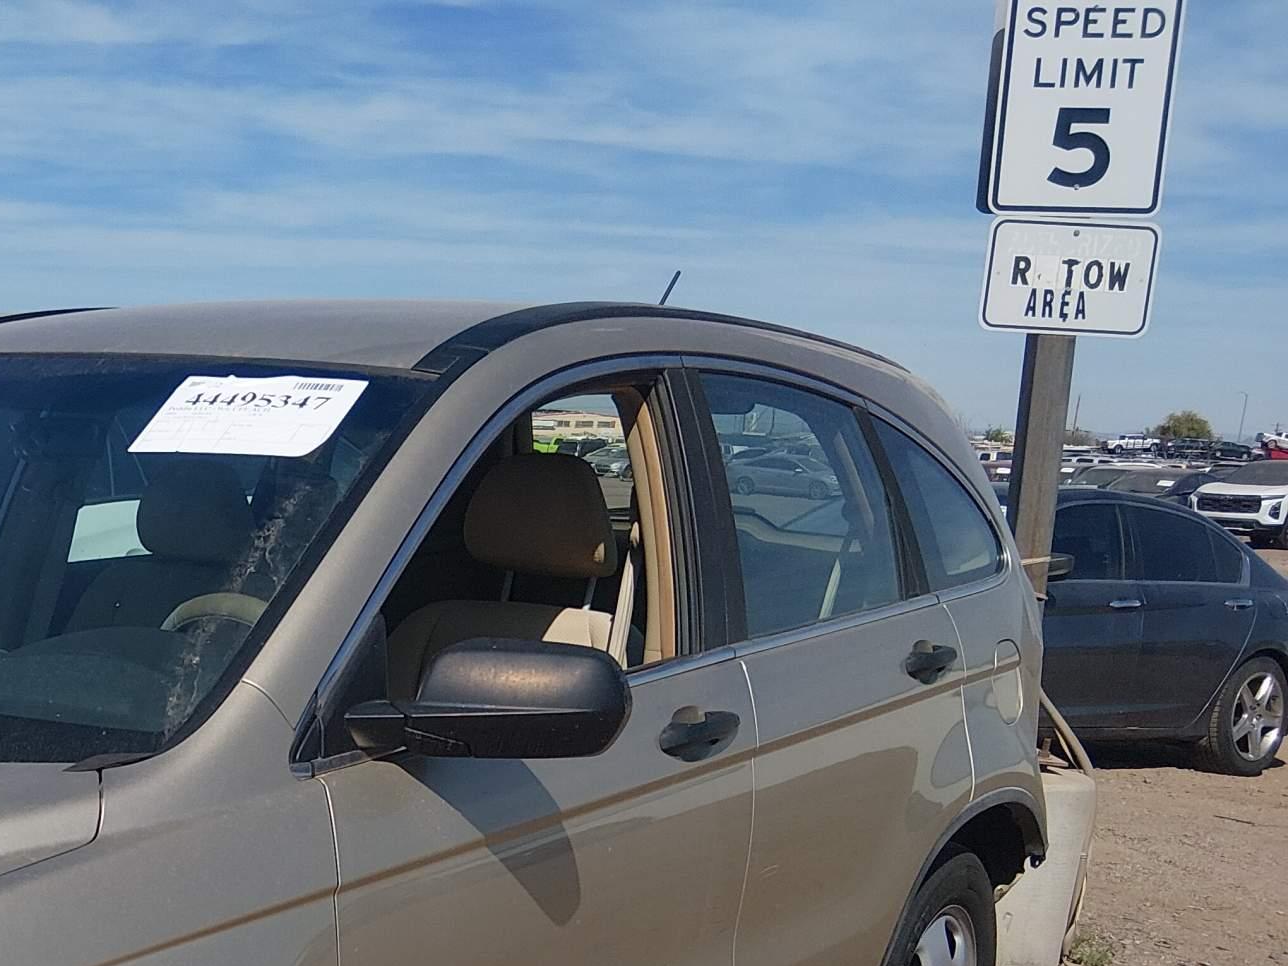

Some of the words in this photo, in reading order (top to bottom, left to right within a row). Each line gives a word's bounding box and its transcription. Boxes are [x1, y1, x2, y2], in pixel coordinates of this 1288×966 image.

[1023, 6, 1167, 39] SPEED
[1033, 57, 1145, 89] LIMIT
[1046, 106, 1111, 189] 5
[1062, 258, 1131, 291] TOW
[1024, 288, 1087, 321] AREA
[185, 391, 332, 411] 44495347
